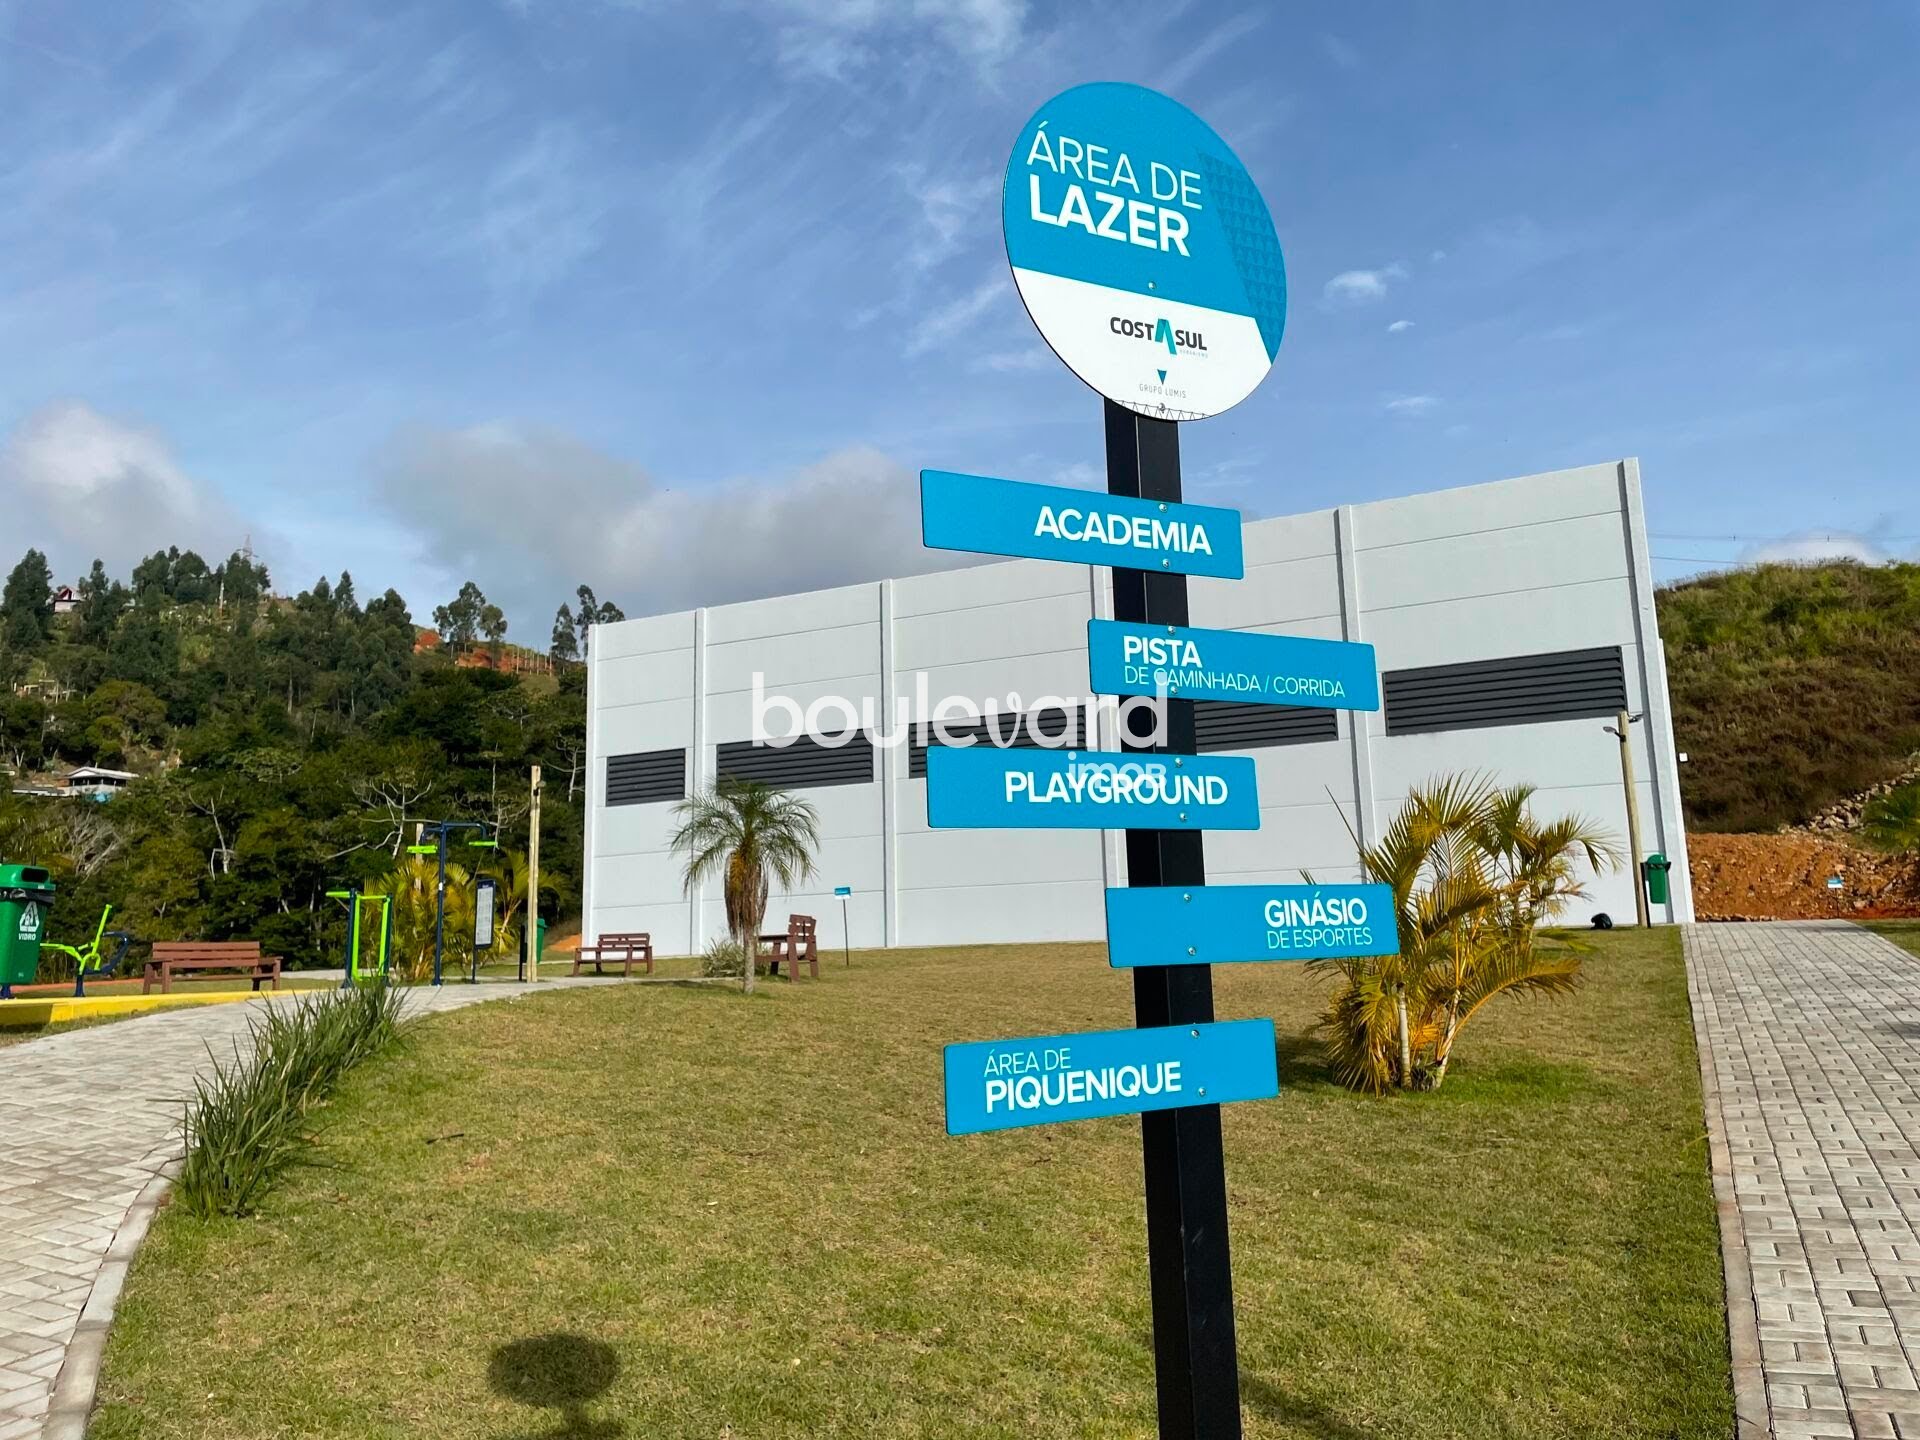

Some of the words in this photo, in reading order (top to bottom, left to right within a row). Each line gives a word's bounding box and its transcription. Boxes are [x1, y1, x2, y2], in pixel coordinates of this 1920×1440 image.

[1026, 121, 1140, 194] ÁREA
[1150, 161, 1202, 210] DE
[1029, 173, 1191, 257] LAZER
[1139, 383, 1163, 395] GRUPO
[1165, 387, 1187, 399] LUMIS
[1034, 505, 1213, 556] ACADEMIA
[1123, 635, 1202, 668] PISTA
[1124, 665, 1149, 685] DE
[1153, 668, 1262, 692] CAMINHADA
[1273, 676, 1345, 698] CORRIDA
[1005, 770, 1229, 806] PLAYGROUND
[1264, 891, 1368, 928] GINÁSIO
[18, 933, 37, 941] VIDRO
[1267, 929, 1290, 949] DE
[1293, 927, 1373, 948] ESPORTES
[983, 1049, 1040, 1078] ÁREA
[1044, 1048, 1071, 1071] DE
[985, 1061, 1182, 1114] PIQUENIQUE
